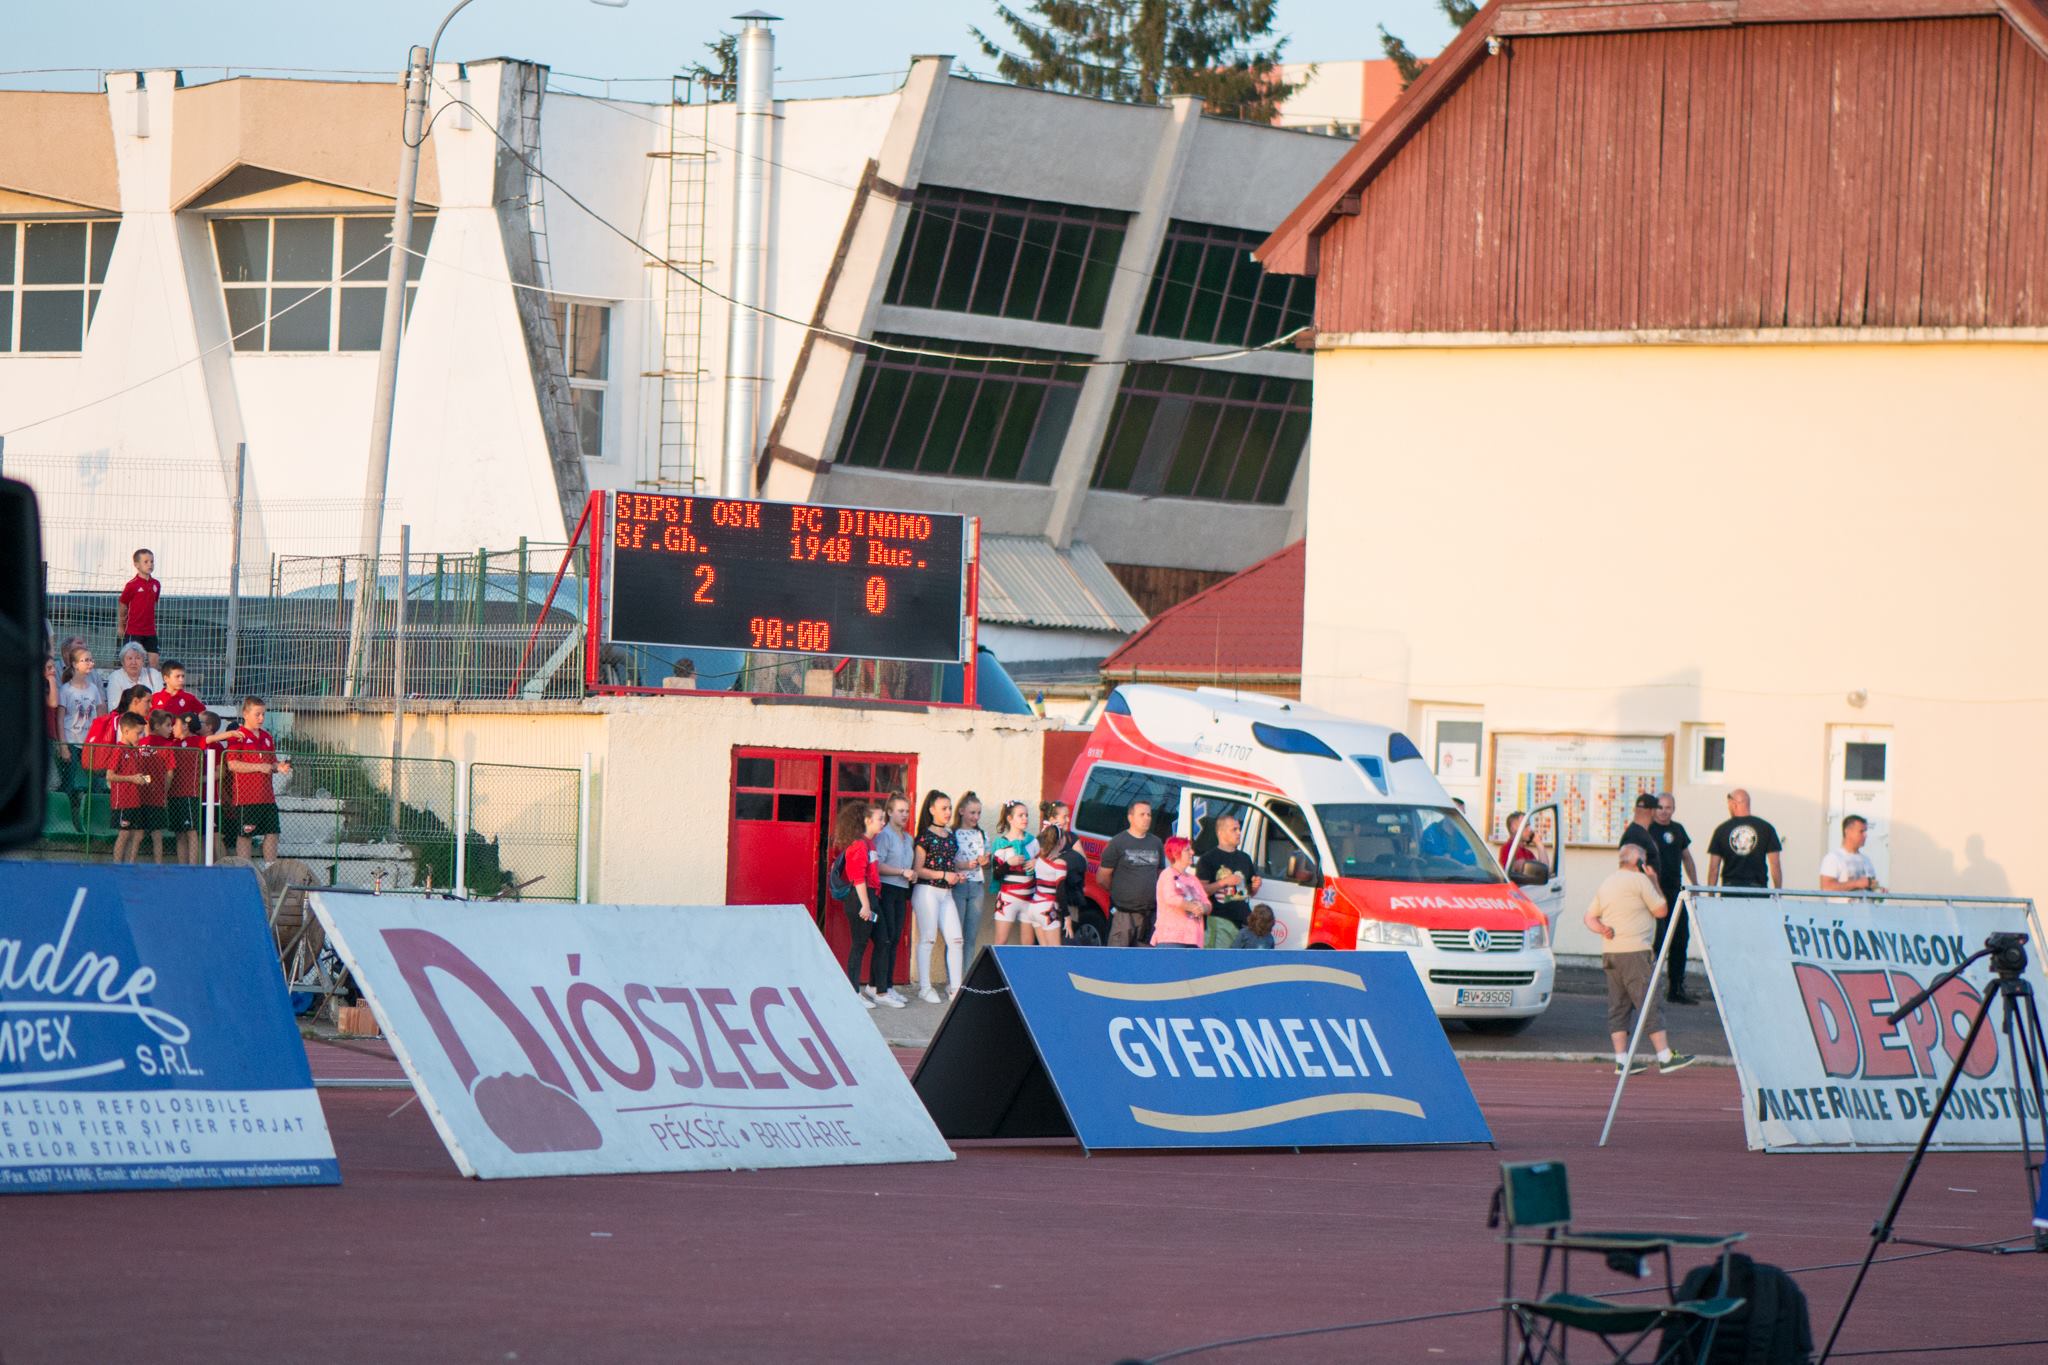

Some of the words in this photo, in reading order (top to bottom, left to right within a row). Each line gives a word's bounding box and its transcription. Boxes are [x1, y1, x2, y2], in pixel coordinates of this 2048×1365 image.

[616, 494, 693, 524] SEPSI
[712, 501, 761, 529] OSK
[791, 507, 823, 533] FC
[837, 510, 933, 541] DINAMO
[616, 523, 709, 553] Sf.Gh.
[790, 536, 852, 563] 1948
[867, 540, 928, 569] Buc.
[694, 565, 714, 603] 2
[865, 576, 887, 615] 0
[750, 617, 830, 653] 90:00
[1784, 915, 1968, 966] ÉPÍTŐANYAGOK
[136, 1044, 204, 1076] S.R.L.
[1108, 1017, 1393, 1078] GYERMELYI
[4, 1099, 84, 1117] ALELOR
[97, 1098, 250, 1116] REFOLOSIBILE
[1758, 1085, 1892, 1122] MATERIALE
[1895, 1087, 1933, 1119] DE
[29, 1120, 63, 1136] DIN
[79, 1120, 128, 1136] FIER
[173, 1118, 218, 1134] FIER
[230, 1117, 305, 1133] FORJAT
[650, 1112, 740, 1151] PÉKSÉG
[751, 1114, 861, 1149] BRUTĂRIE
[0, 1141, 77, 1159] RELOR
[90, 1139, 192, 1157] STIRLING
